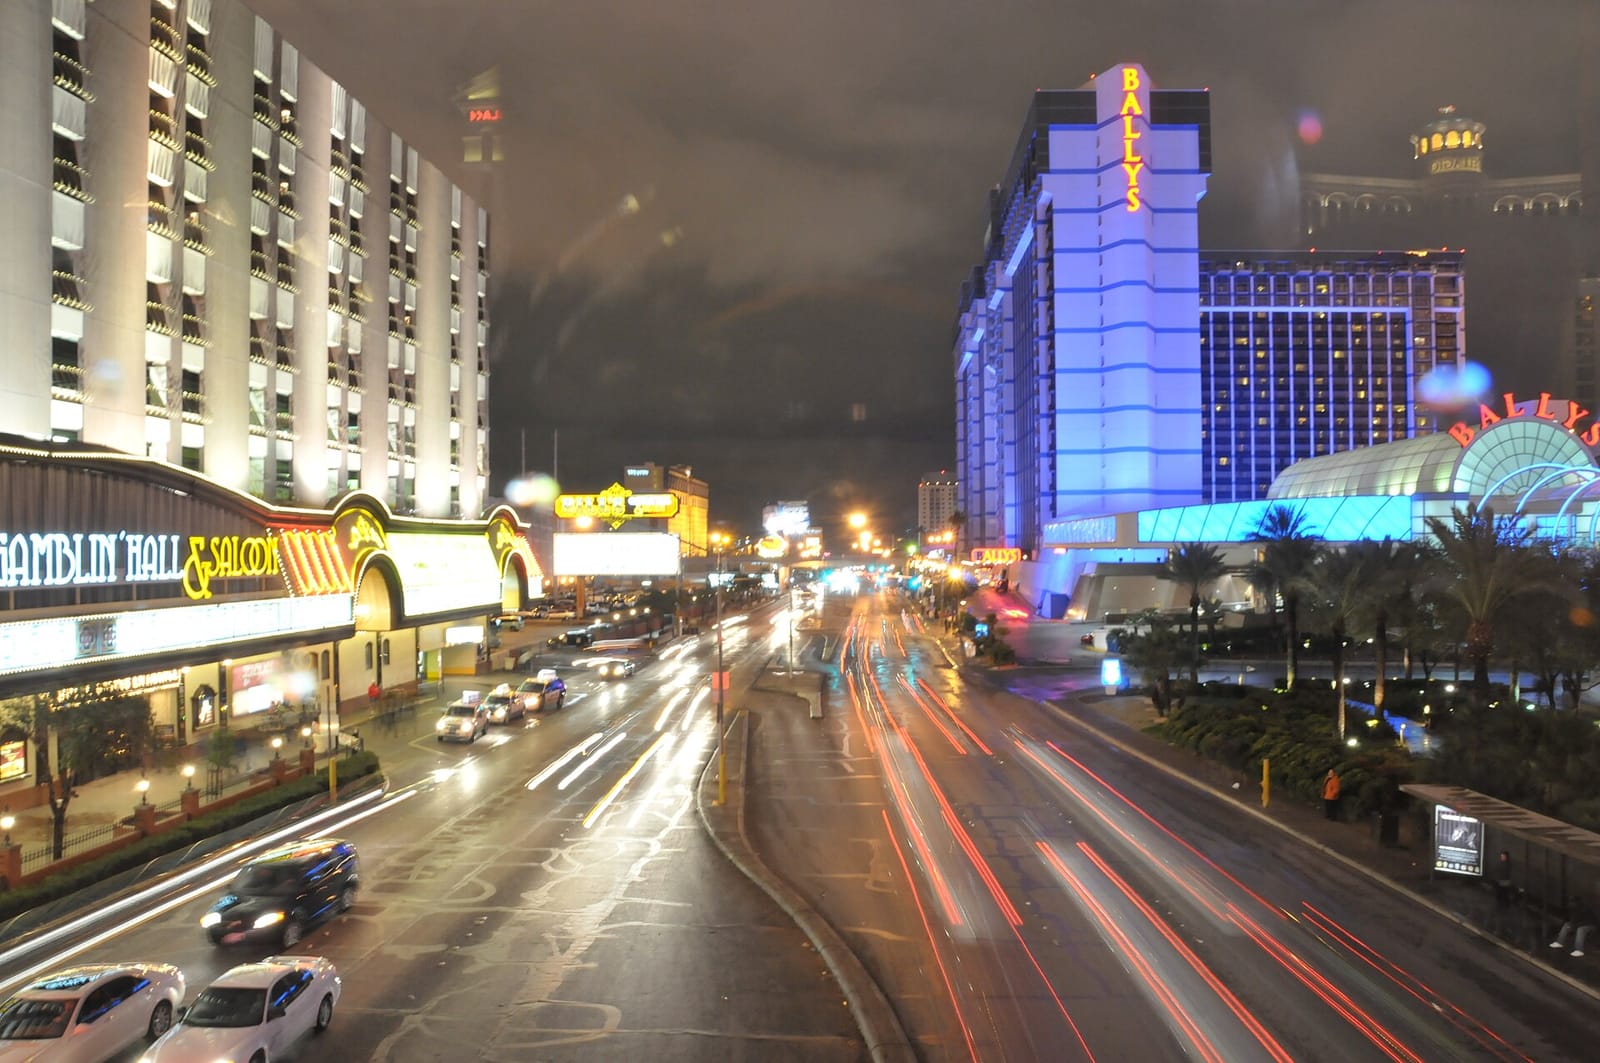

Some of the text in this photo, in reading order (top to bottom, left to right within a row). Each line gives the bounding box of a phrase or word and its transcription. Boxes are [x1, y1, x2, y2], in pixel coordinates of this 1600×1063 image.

[1120, 67, 1145, 213] BALLYS
[1448, 392, 1600, 448] BALLYS
[126, 534, 184, 581] HALL
[183, 536, 212, 599] &
[209, 536, 279, 576] SALOON
